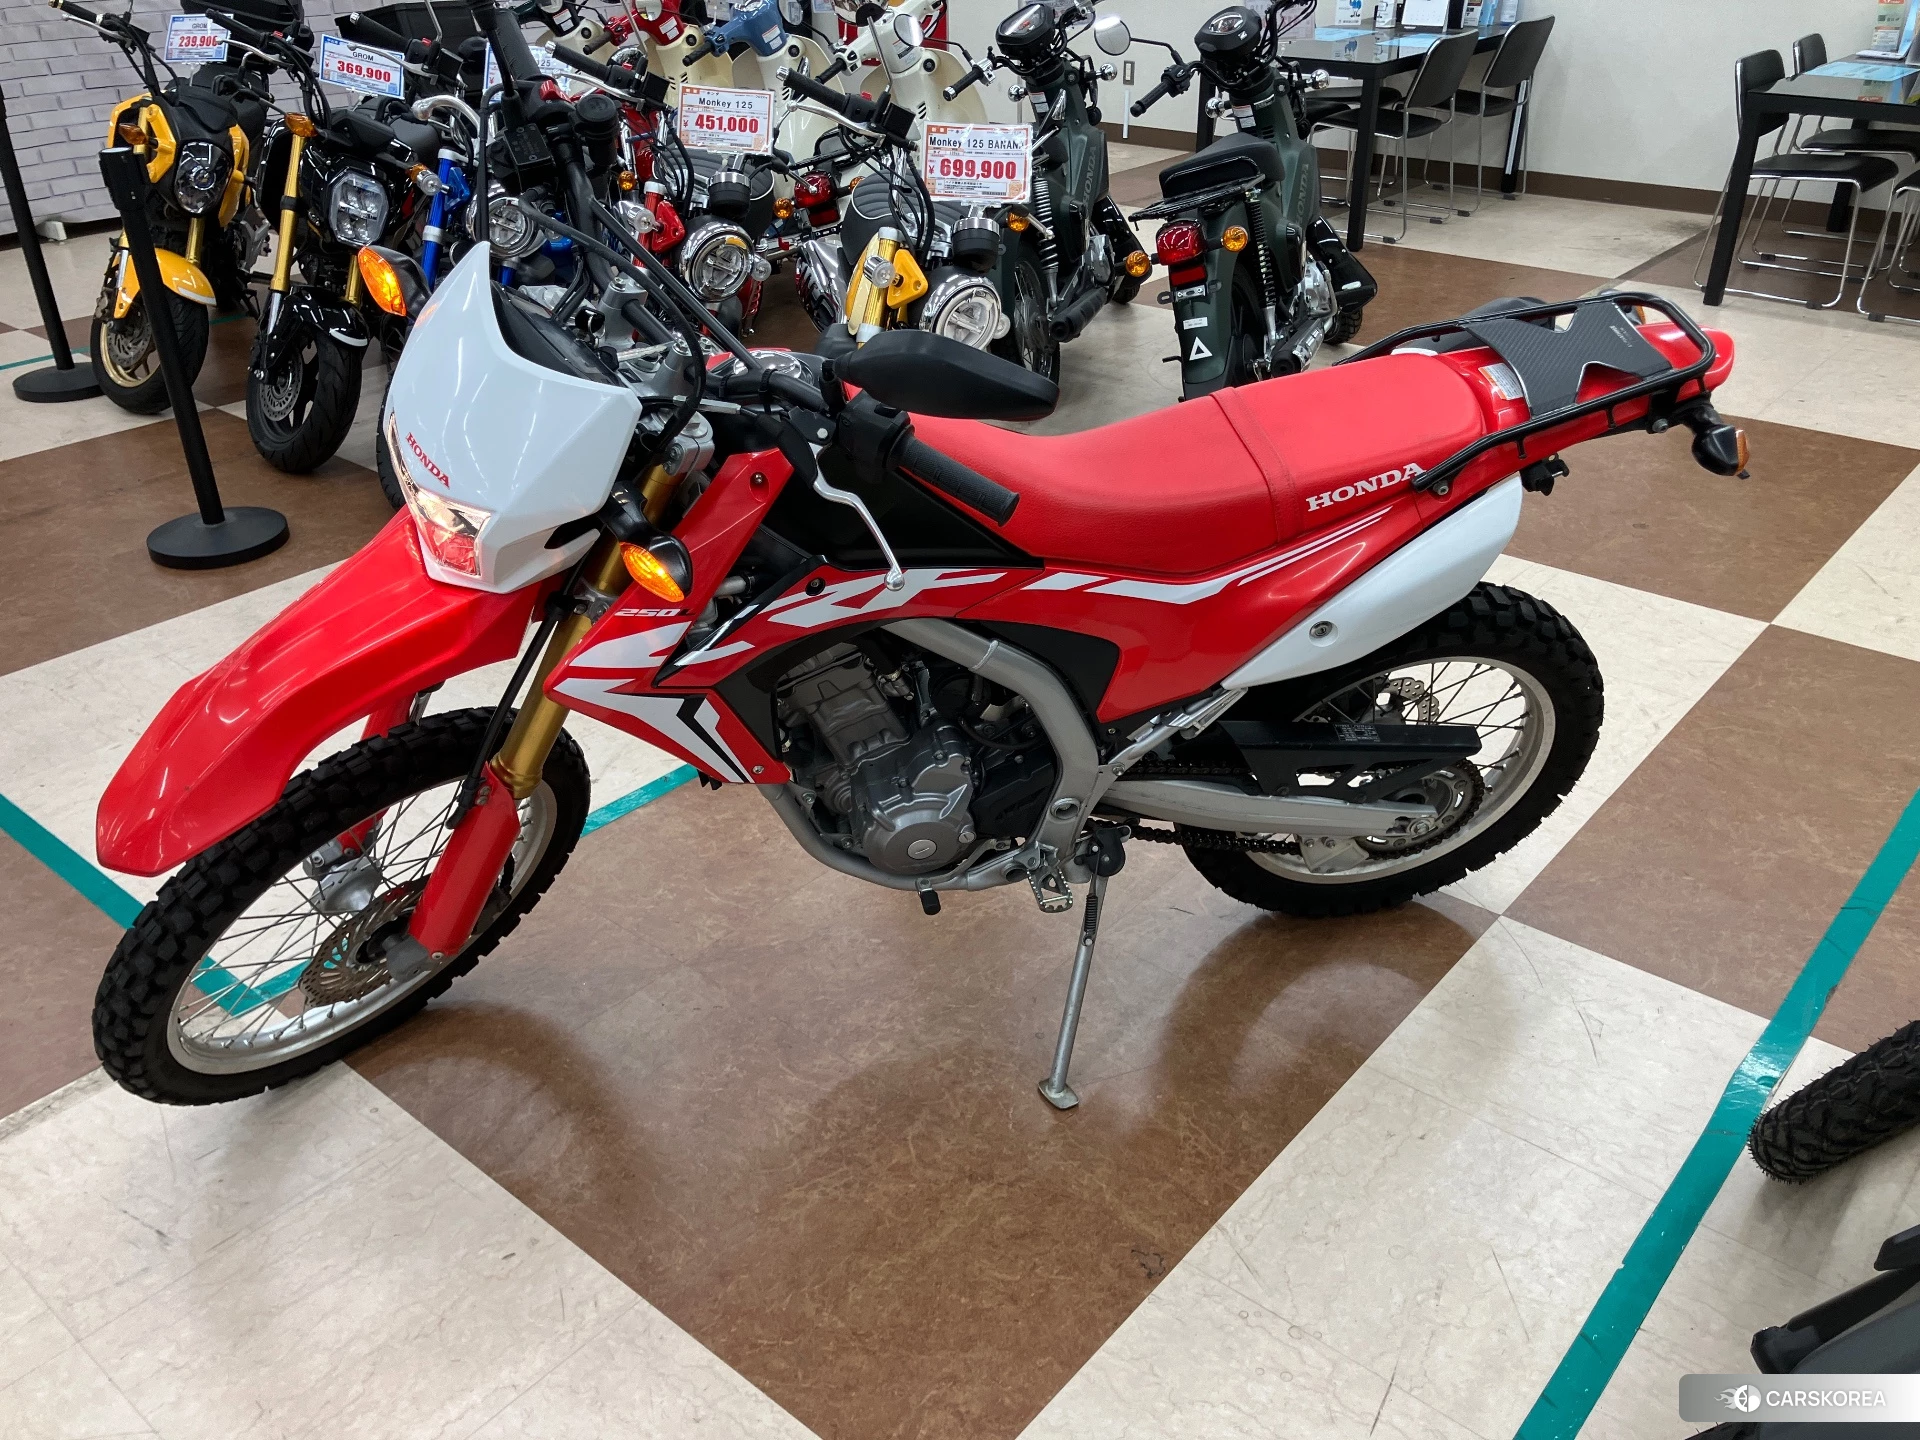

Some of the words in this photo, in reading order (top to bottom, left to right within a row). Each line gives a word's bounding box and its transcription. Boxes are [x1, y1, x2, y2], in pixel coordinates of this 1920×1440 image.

[352, 51, 374, 61] GROM
[337, 60, 391, 82] 369,900
[698, 98, 731, 109] Monkey
[735, 101, 753, 109] 125
[695, 114, 759, 134] 451,000
[929, 136, 962, 148] Monkey
[967, 139, 984, 149] 125
[940, 158, 1017, 180] 699,900
[406, 432, 450, 489] HONDA
[1305, 462, 1427, 511] HONDA
